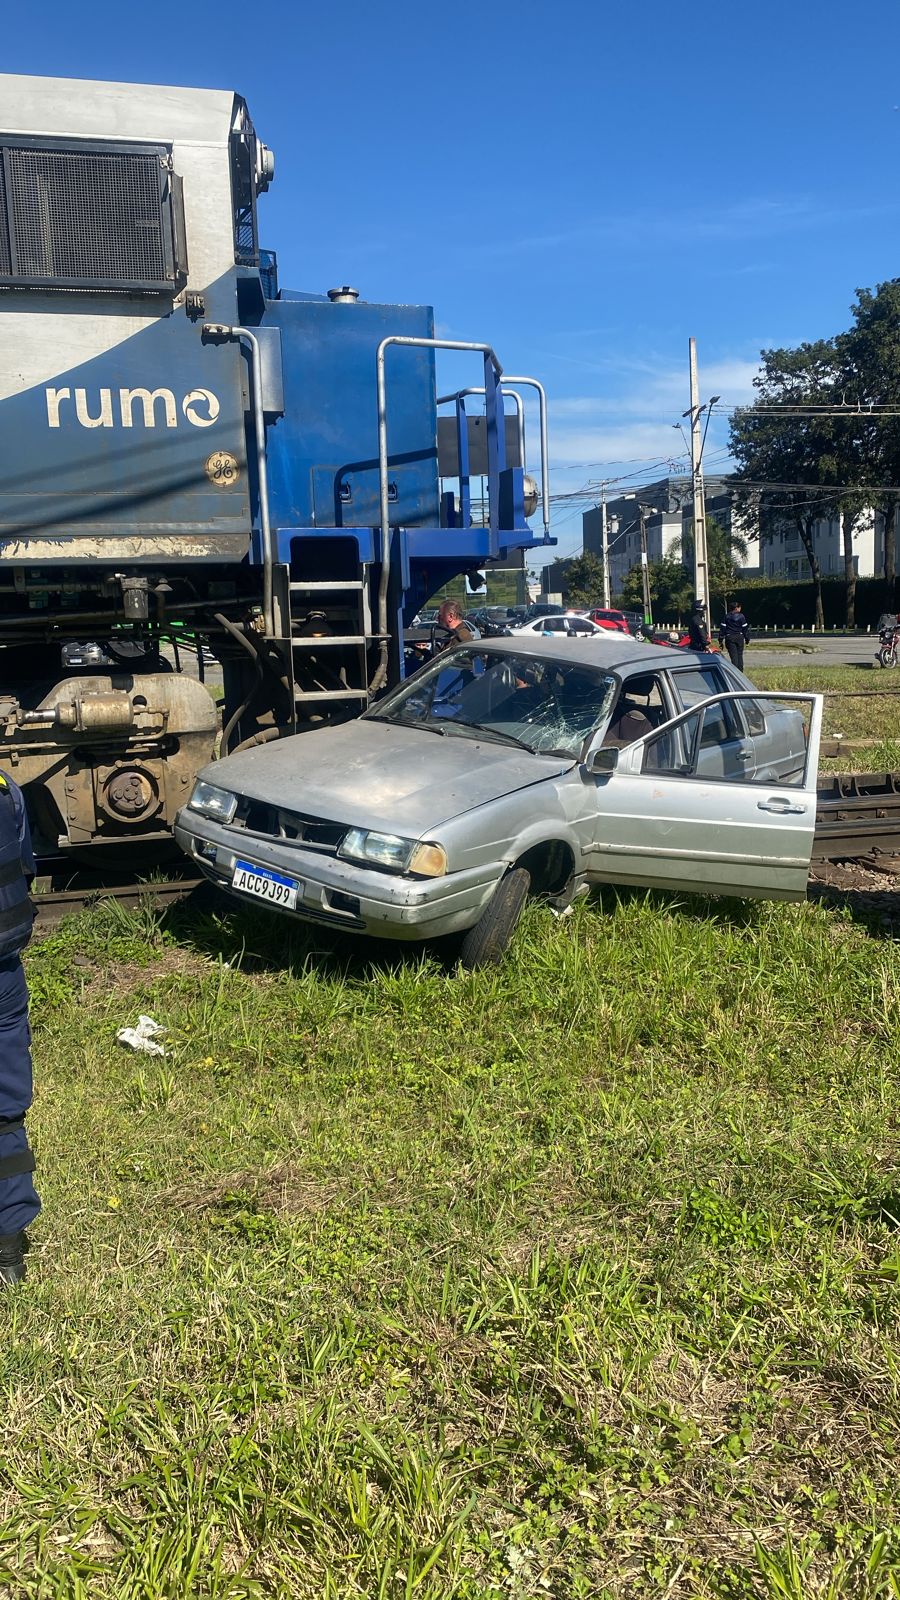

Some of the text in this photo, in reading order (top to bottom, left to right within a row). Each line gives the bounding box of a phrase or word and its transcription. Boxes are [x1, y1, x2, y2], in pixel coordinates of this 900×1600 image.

[45, 388, 220, 428] rumo
[213, 460, 233, 479] GE
[239, 872, 290, 903] ACC9J99
